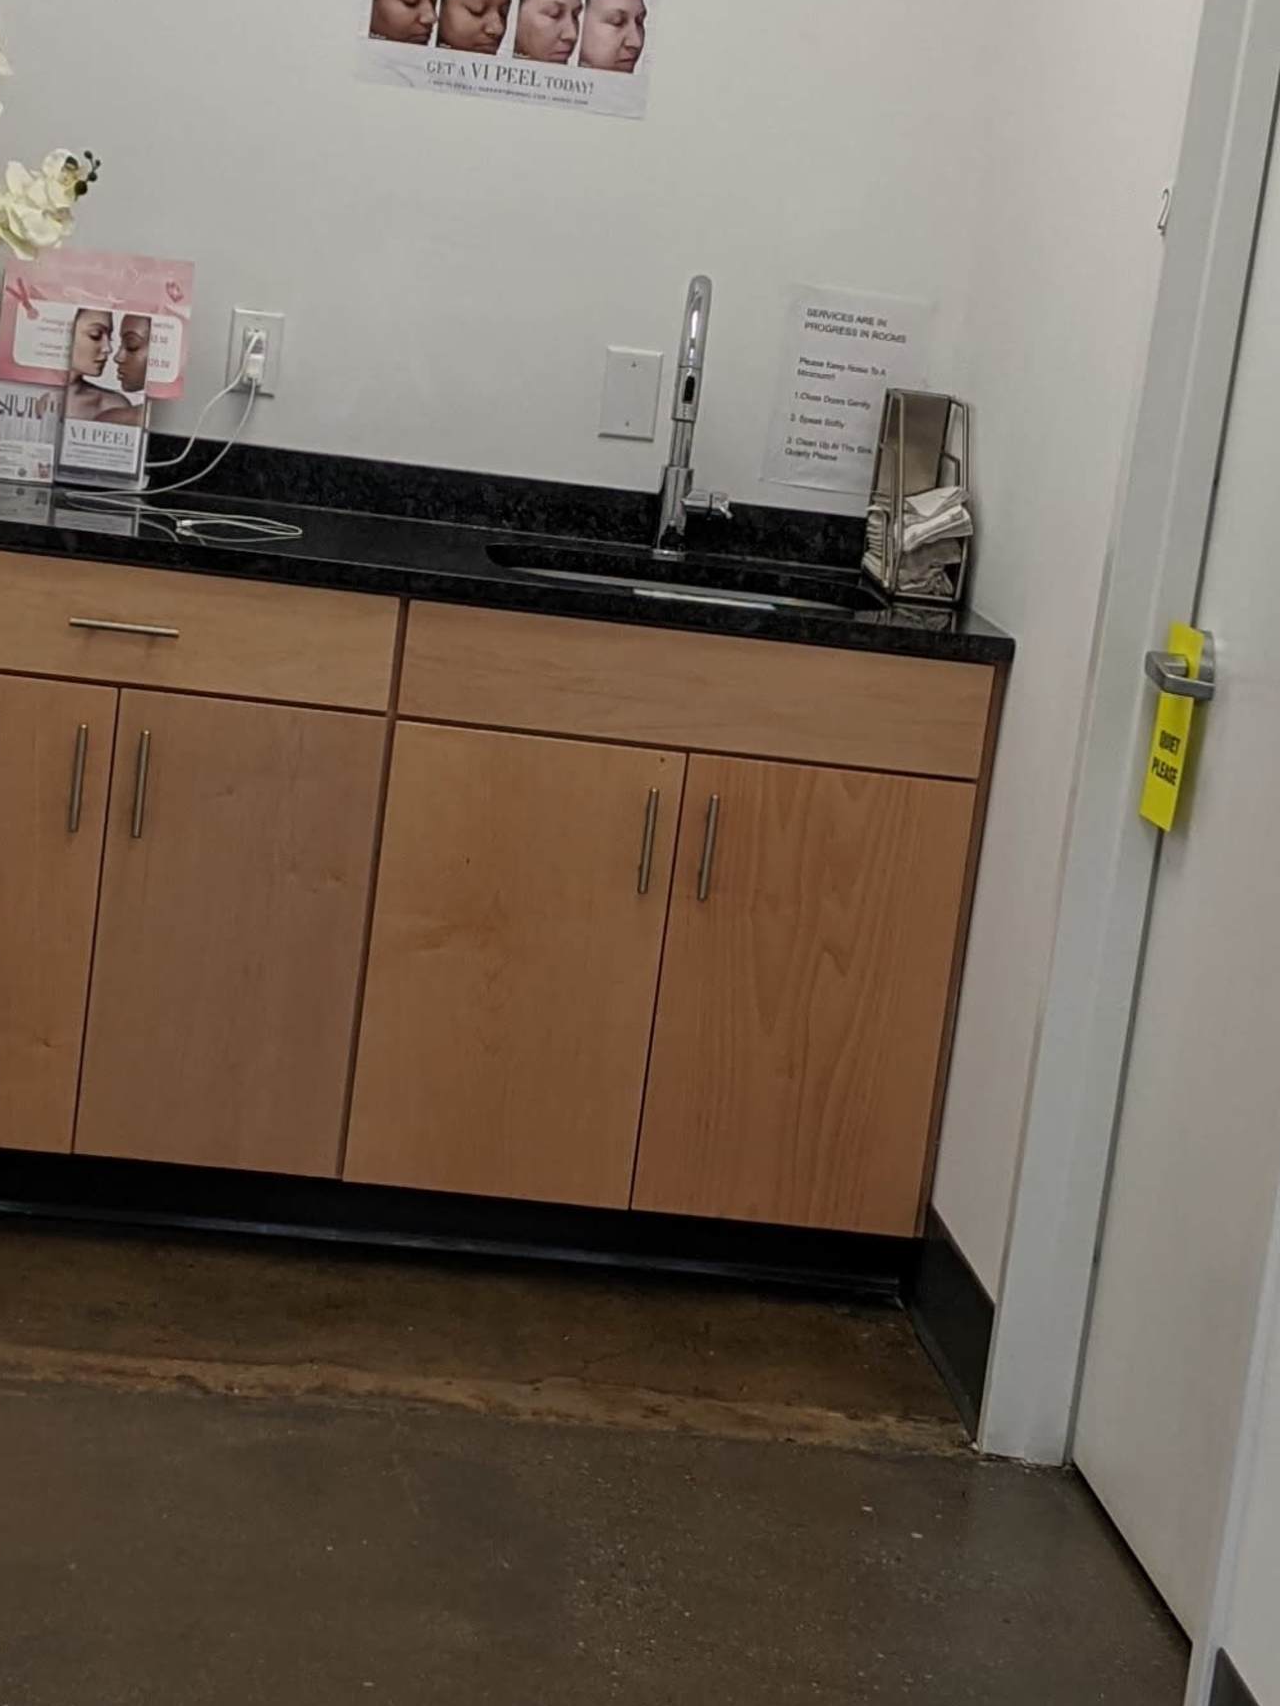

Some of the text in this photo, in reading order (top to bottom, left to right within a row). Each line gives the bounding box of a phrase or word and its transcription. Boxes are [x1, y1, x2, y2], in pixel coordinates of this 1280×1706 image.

[426, 59, 458, 75] GET
[459, 64, 466, 77] A
[470, 61, 489, 81] VI
[495, 65, 541, 87] PEEL
[544, 75, 595, 94] TODAY!
[806, 307, 888, 328] SERVICES ARE IN
[804, 321, 906, 344] PROGRESS IN ROOMS
[799, 356, 825, 368] Please
[823, 394, 846, 406] Doors
[70, 426, 136, 447] VI PEEL
[1159, 730, 1181, 756] QUIET
[1152, 756, 1178, 786] PLEASE
